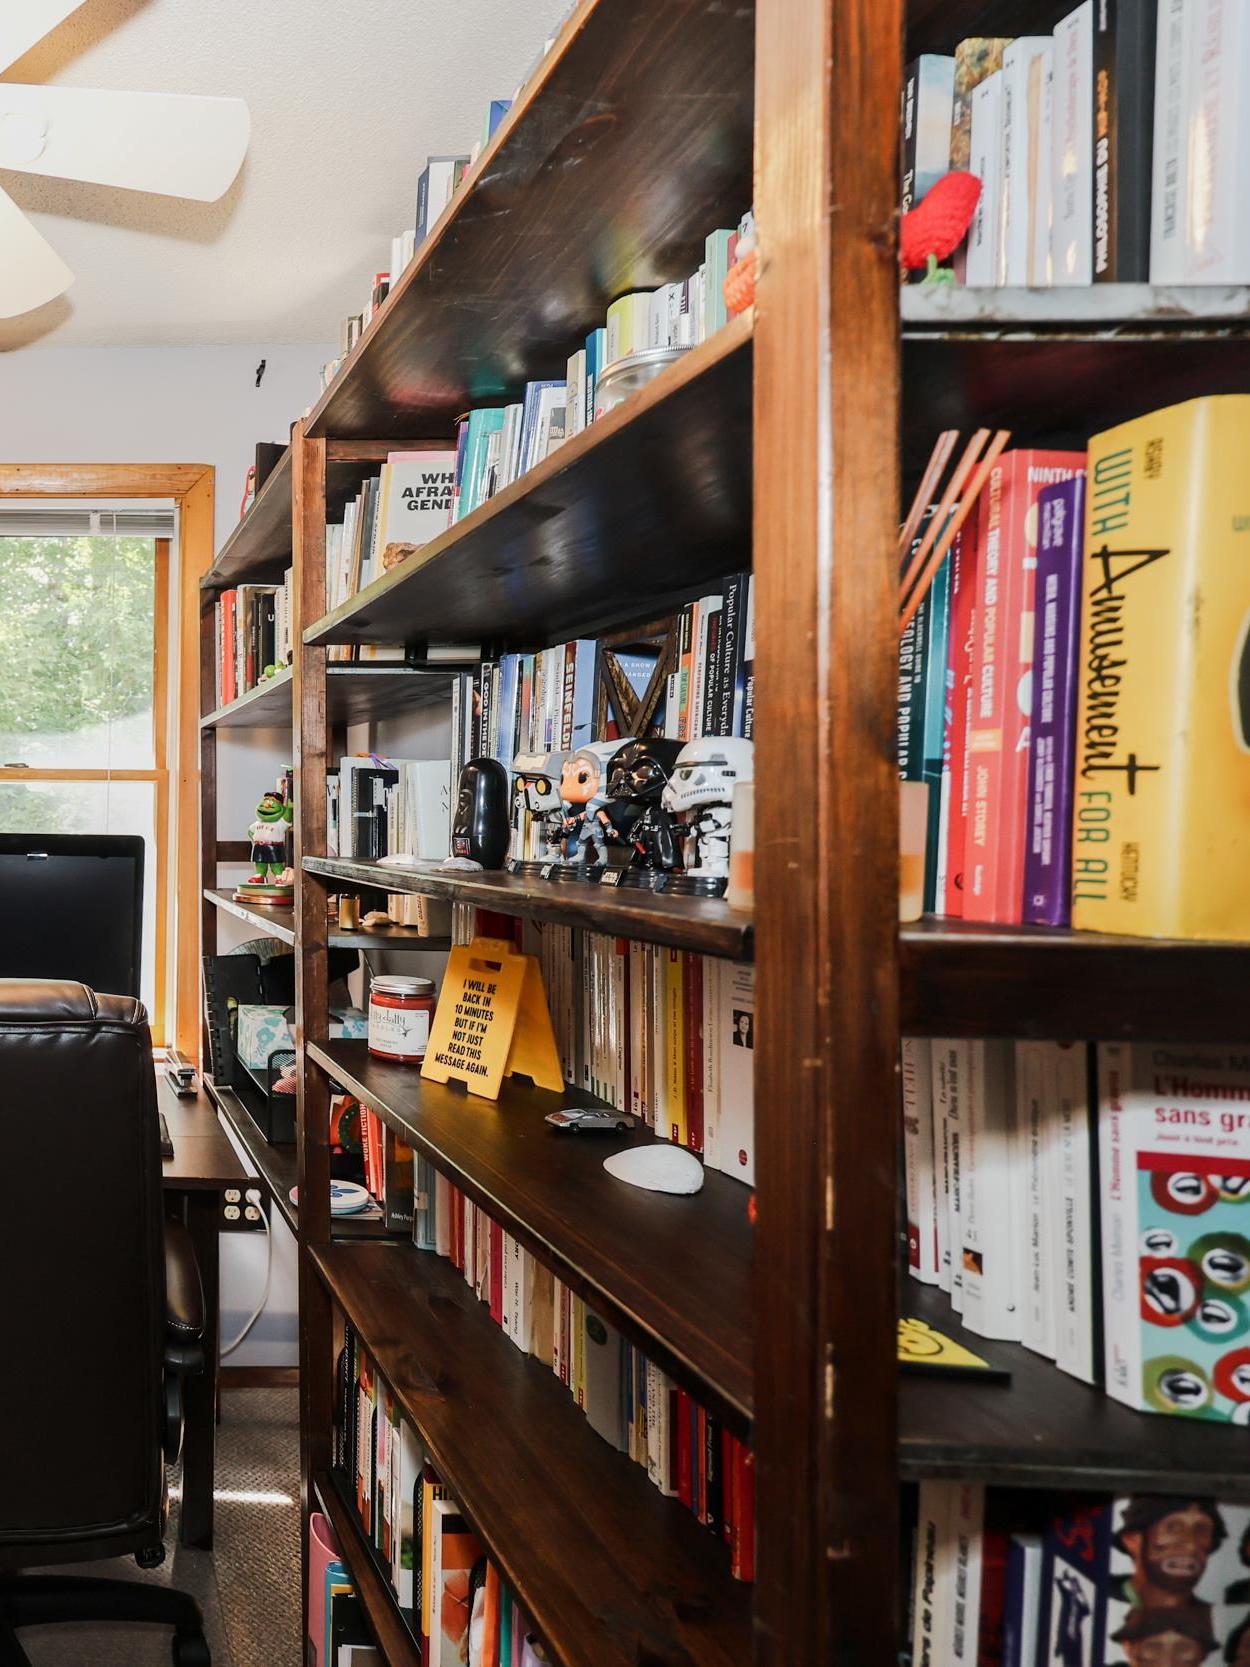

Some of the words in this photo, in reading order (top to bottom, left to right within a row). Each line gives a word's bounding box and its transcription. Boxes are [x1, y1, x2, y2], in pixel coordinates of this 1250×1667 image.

[1027, 466, 1071, 483] NINTH
[402, 486, 452, 498] AFRA
[1092, 447, 1133, 536] WITH
[984, 578, 998, 605] AND
[726, 585, 737, 627] Popular
[709, 653, 715, 663] OF
[724, 631, 734, 674] Culture
[707, 665, 715, 698] POPULAR
[723, 677, 730, 689] as
[745, 676, 754, 706] Popular
[898, 675, 913, 703] AND
[980, 664, 995, 718] CULTURE
[483, 709, 488, 721] IN
[562, 662, 574, 751] SEINFELDI
[705, 700, 713, 731] CULTURE
[719, 692, 731, 736] Everyda
[744, 709, 753, 737] Culture
[976, 765, 988, 798] JOHN
[974, 800, 987, 847] STOREY
[1077, 789, 1112, 844] FOR
[1072, 857, 1109, 907] ALL
[463, 979, 467, 987] I
[467, 980, 485, 992] WILL
[488, 984, 497, 995] BE
[463, 992, 480, 1005] BACK
[483, 997, 491, 1007] IN
[455, 1004, 463, 1014] 10
[464, 1006, 494, 1021] MINUTES
[455, 1018, 467, 1029] BUT
[469, 1020, 475, 1030] IF
[476, 1022, 488, 1033] I'M
[448, 1043, 466, 1055] READ
[467, 1047, 482, 1060] THIS
[452, 1031, 466, 1043] NOT
[467, 1034, 484, 1046] JUST
[435, 1053, 465, 1070] MESSAGE
[466, 1063, 489, 1077] AGAIN.
[360, 1103, 368, 1135] FICTION
[1155, 1107, 1210, 1125] sans
[361, 1137, 369, 1162] WOKE
